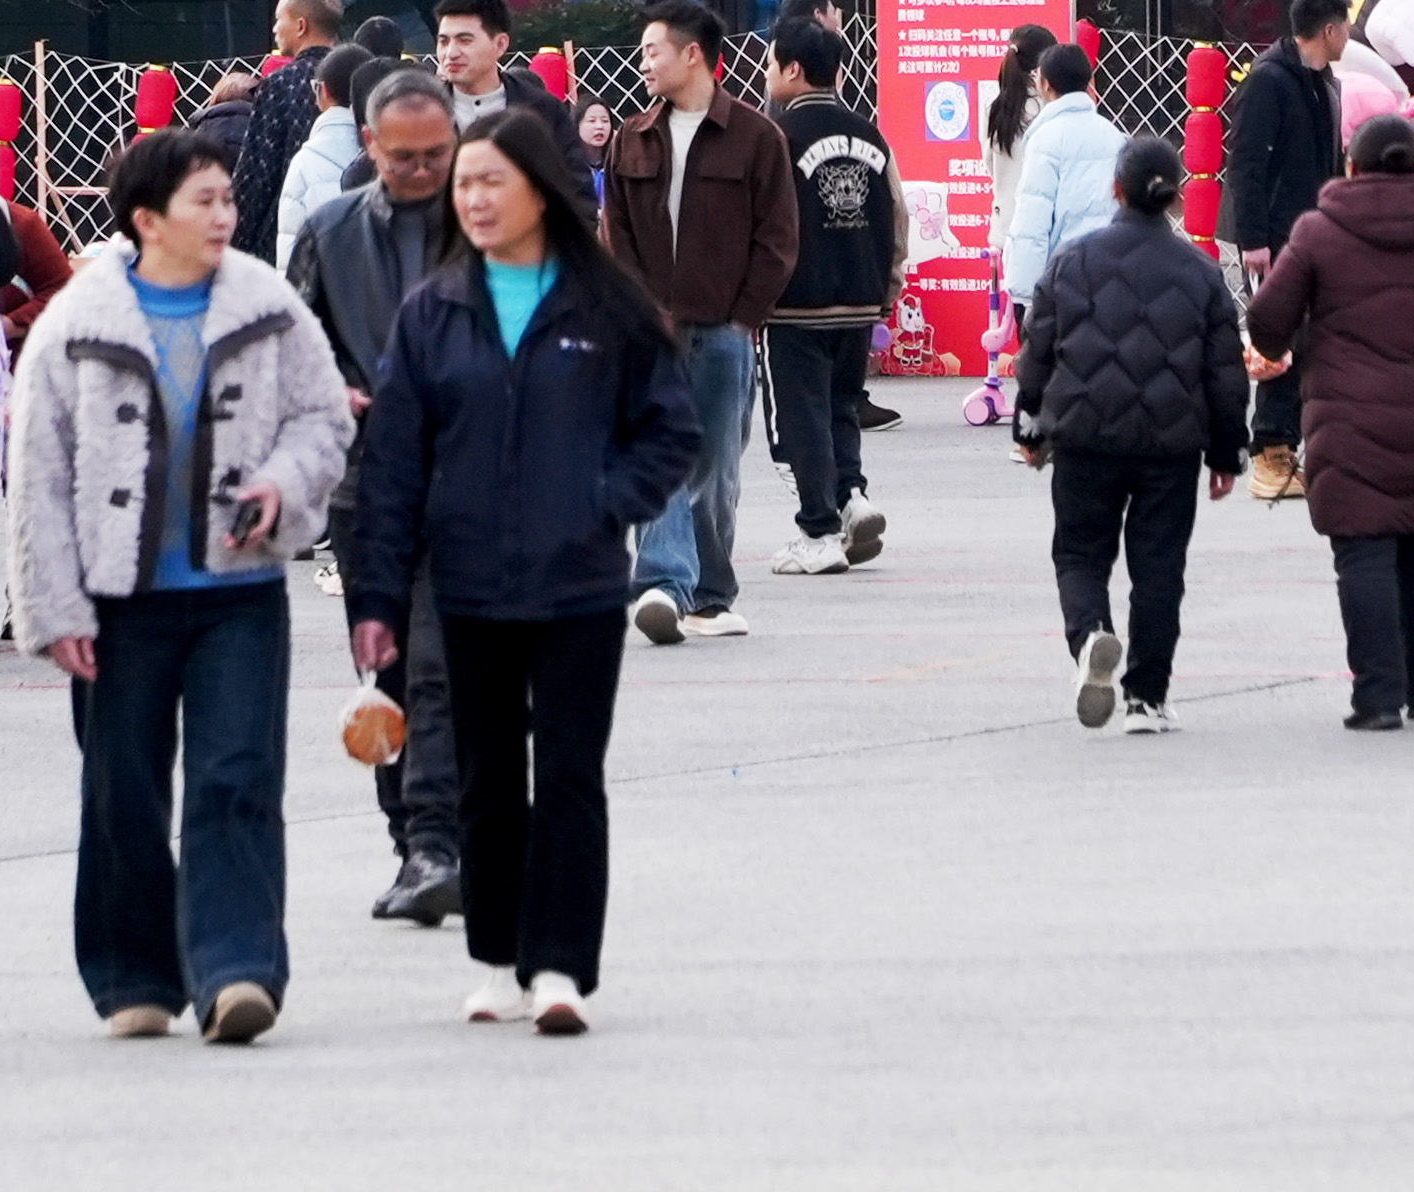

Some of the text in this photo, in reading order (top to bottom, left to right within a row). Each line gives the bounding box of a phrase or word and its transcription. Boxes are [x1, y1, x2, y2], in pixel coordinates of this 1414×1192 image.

[796, 134, 850, 181] ALWAYS
[948, 158, 990, 177] 奖项设
